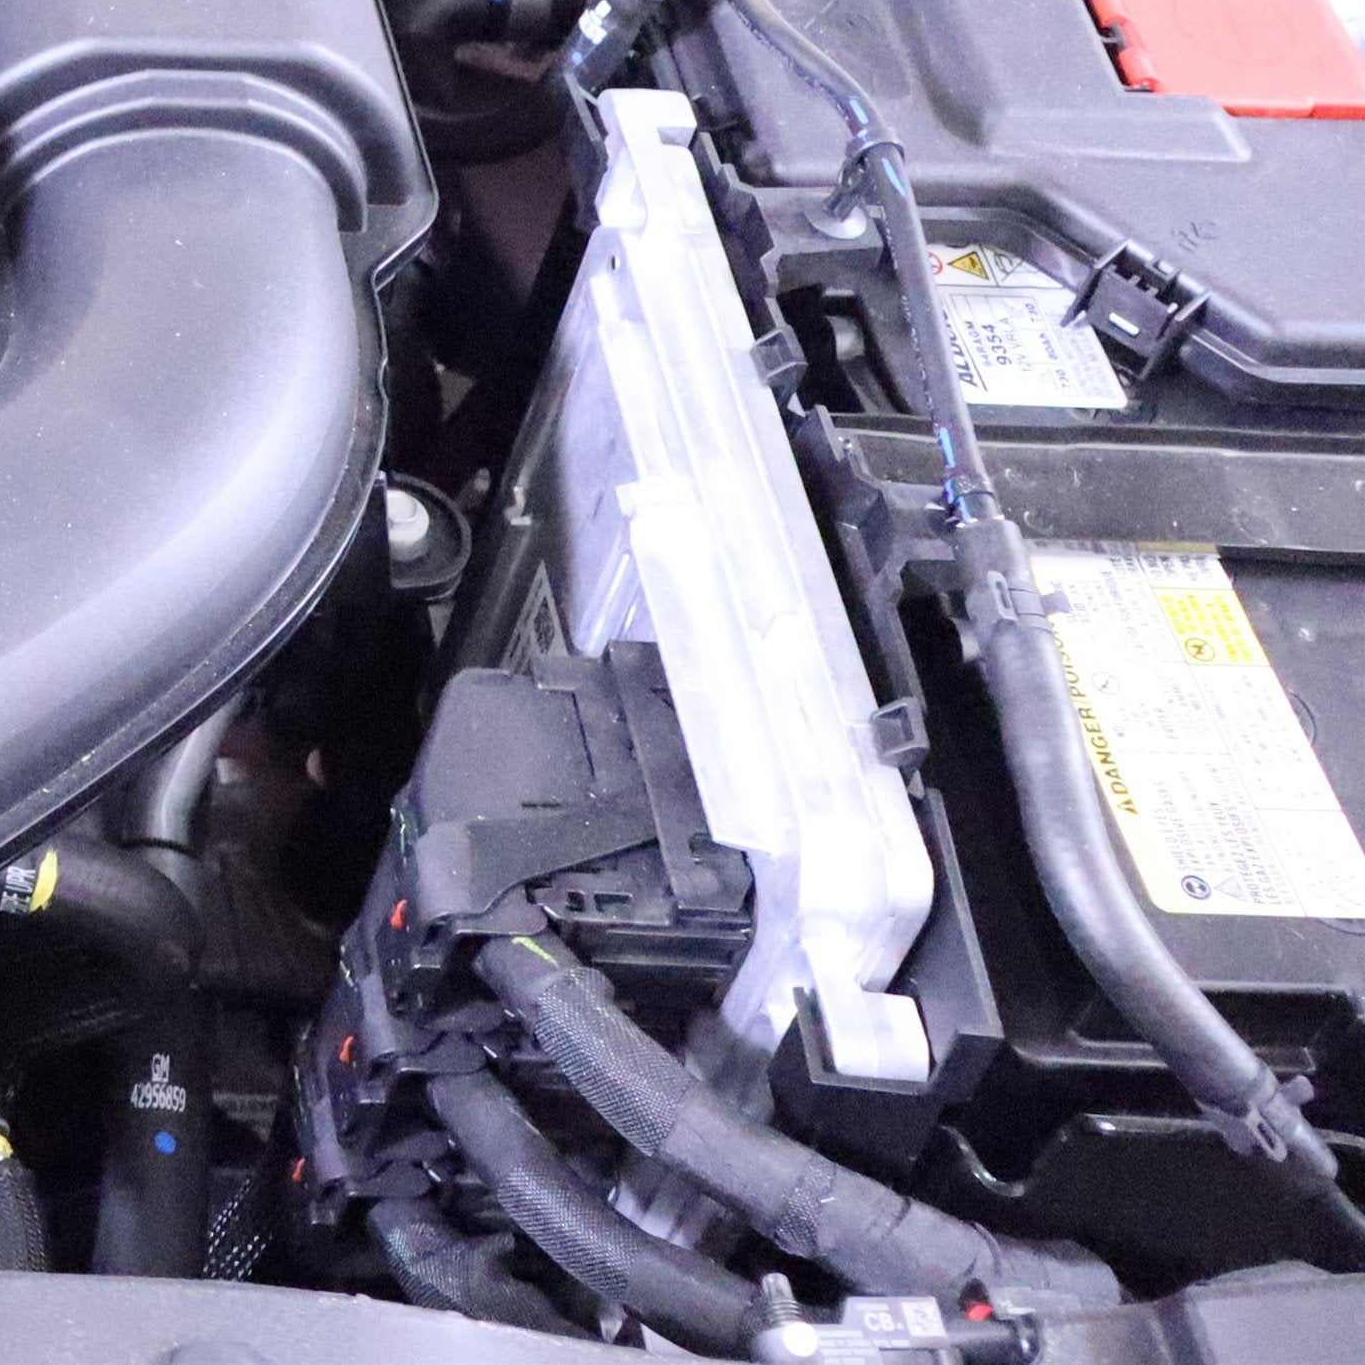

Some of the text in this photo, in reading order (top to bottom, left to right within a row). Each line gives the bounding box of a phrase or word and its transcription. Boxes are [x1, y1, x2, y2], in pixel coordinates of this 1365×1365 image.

[980, 323, 1012, 365] 9354
[1154, 779, 1205, 871] EXPLOSIVE GASES
[1210, 801, 1230, 826] YEUX
[1154, 807, 1191, 871] SHIELD EYES
[1223, 830, 1240, 848] LES
[1226, 805, 1261, 860] EXPLOSIFS
[1252, 863, 1271, 883] GAZ
[1264, 886, 1282, 904] LES
[151, 1053, 171, 1083] GM
